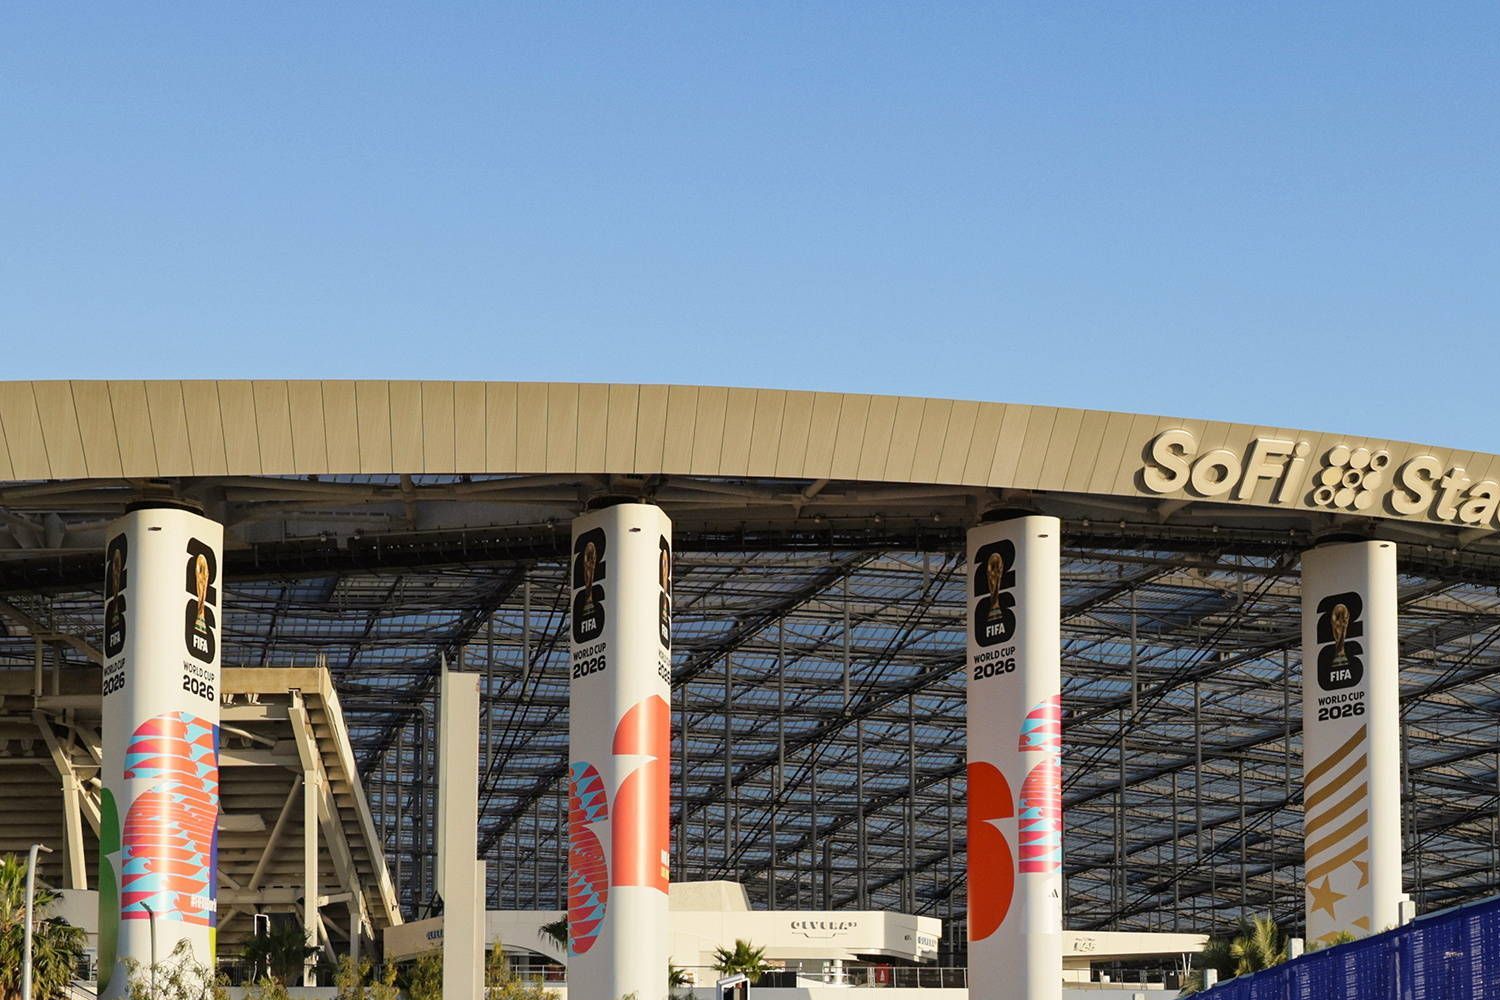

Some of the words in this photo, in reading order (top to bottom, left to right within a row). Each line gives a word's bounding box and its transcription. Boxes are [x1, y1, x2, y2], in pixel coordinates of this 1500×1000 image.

[1143, 428, 1312, 503] SoFi
[581, 618, 597, 633] FIFA
[986, 623, 1005, 637] FIFA
[110, 632, 121, 647] FIFA
[193, 634, 208, 653] FIFA
[573, 648, 594, 661] WORLD
[594, 642, 607, 655] CUP
[973, 650, 1000, 664] WORLD
[1000, 646, 1016, 657] CUP
[183, 661, 203, 678] WORLD
[203, 670, 215, 682] CUP
[572, 655, 606, 680] 2026
[973, 657, 1016, 681] 2026
[1330, 669, 1352, 682] FIFA
[103, 672, 126, 697] 2026
[182, 675, 215, 702] 2026
[1318, 694, 1347, 706] WORLD
[1348, 691, 1365, 701] CUP
[1318, 702, 1365, 722] 2026
